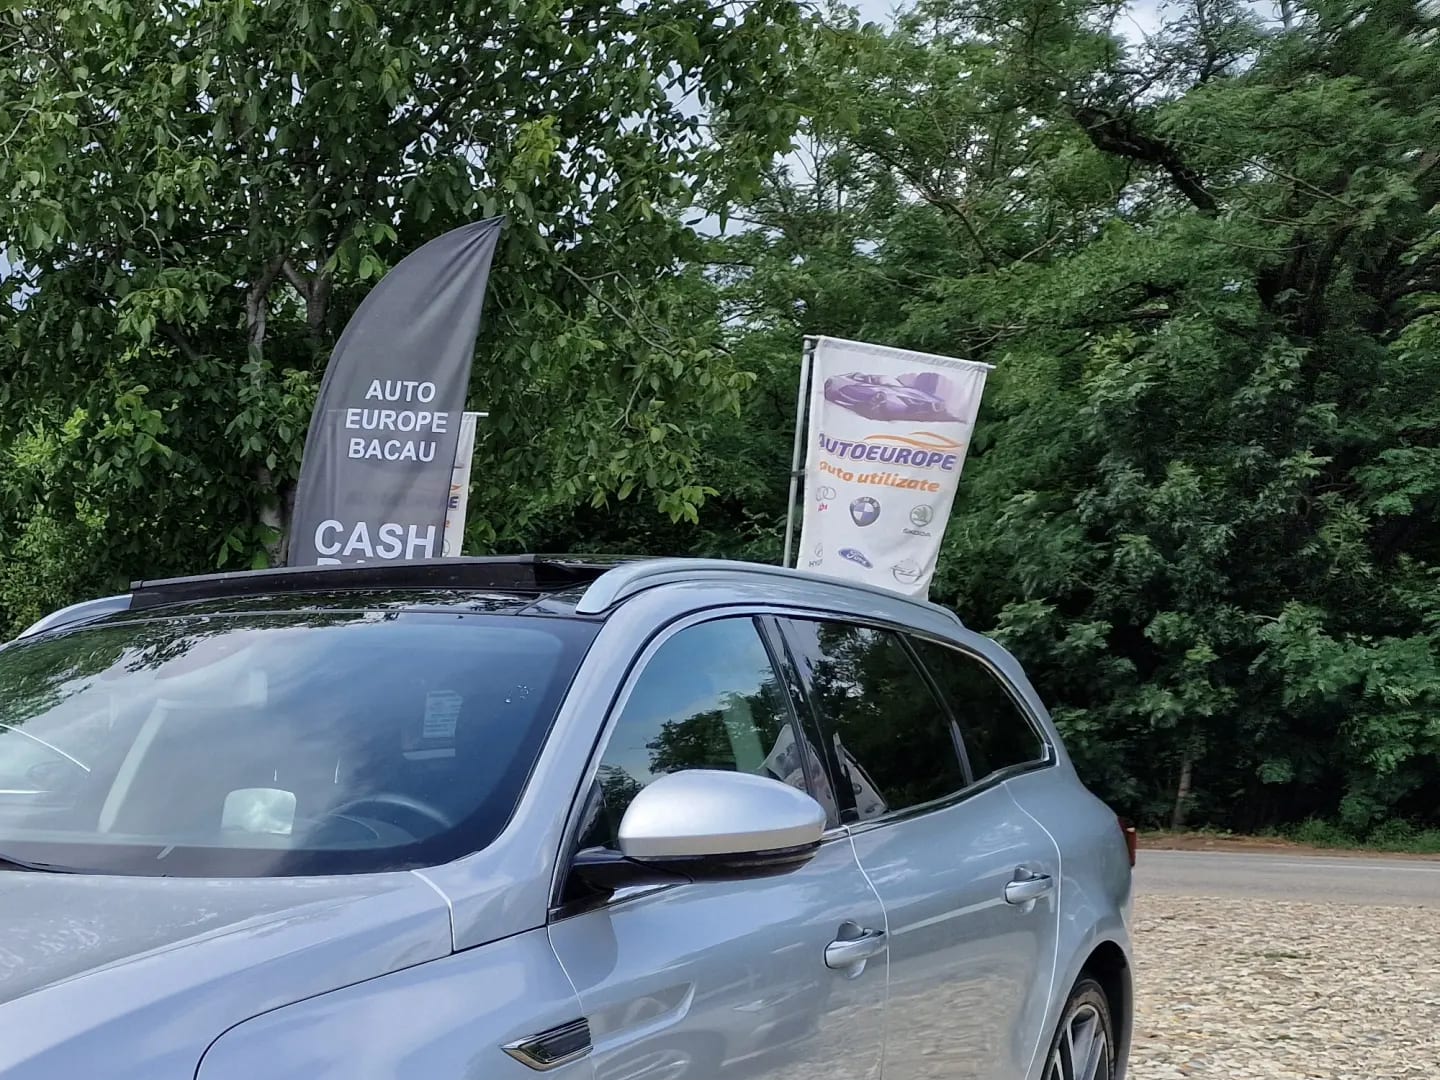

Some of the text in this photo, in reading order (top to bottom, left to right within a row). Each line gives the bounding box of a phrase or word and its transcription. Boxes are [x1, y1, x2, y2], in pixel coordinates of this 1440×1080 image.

[365, 379, 436, 403] AUTO
[345, 408, 449, 433] EUROPE
[348, 438, 437, 462] BACAU
[819, 460, 941, 493] auto utilizate
[314, 519, 436, 559] CASH
